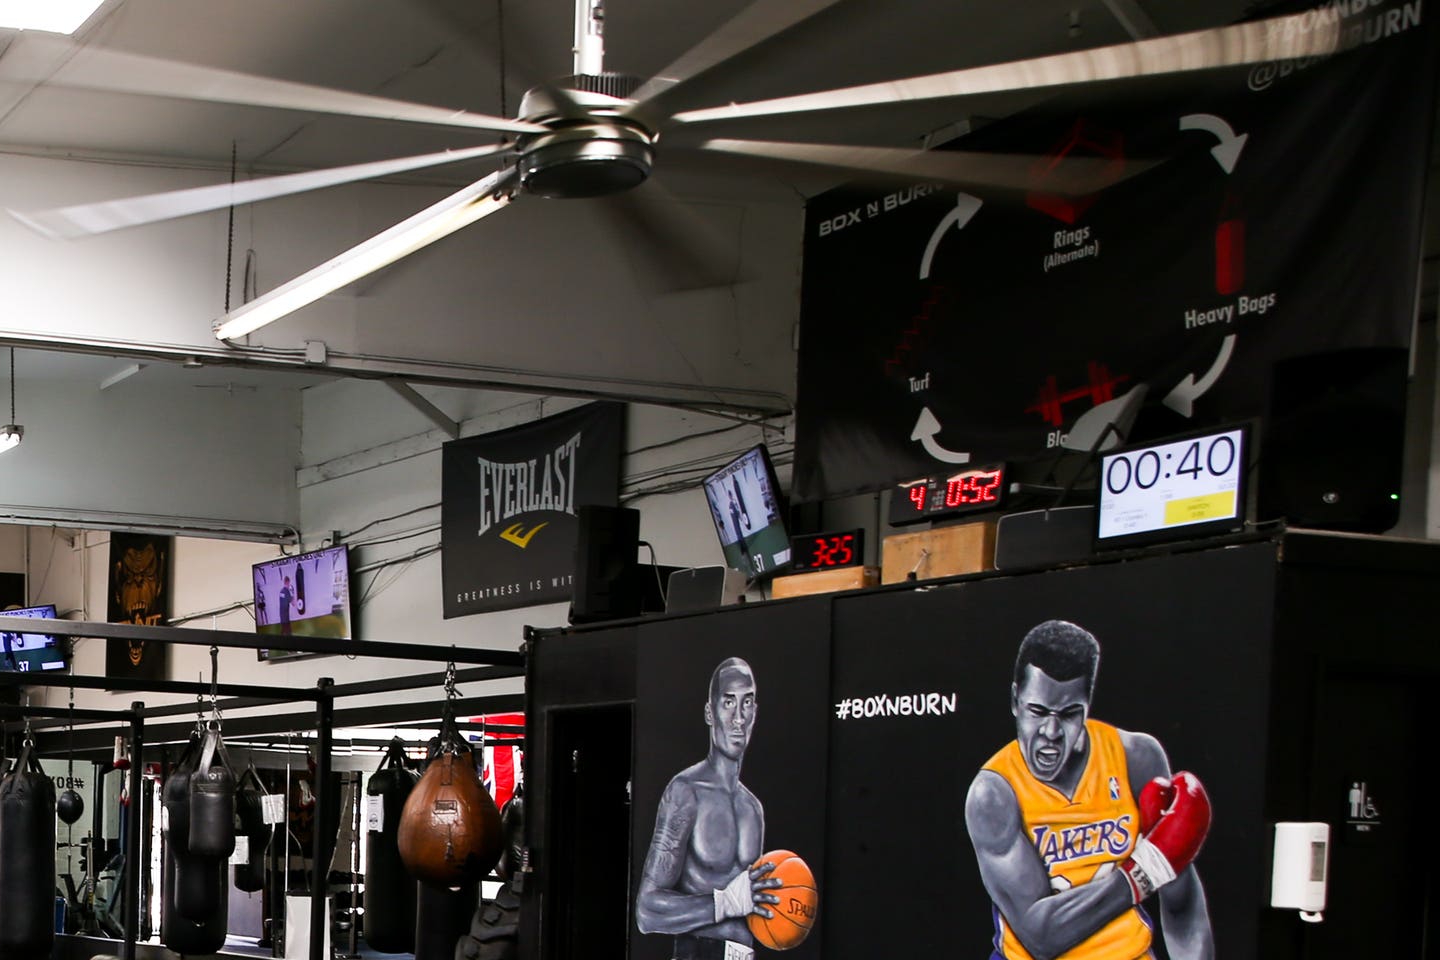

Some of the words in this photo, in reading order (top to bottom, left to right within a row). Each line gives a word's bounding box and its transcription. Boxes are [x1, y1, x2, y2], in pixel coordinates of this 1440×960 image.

[818, 208, 862, 237] BOX
[866, 200, 879, 218] N
[1053, 226, 1091, 249] Rings
[1043, 240, 1101, 272] (Alternate)
[1184, 304, 1234, 330] Heavy
[1238, 292, 1277, 315] Bags
[909, 372, 930, 393] Turf
[1106, 435, 1235, 494] 00:40
[477, 431, 581, 537] EVERLAST
[456, 583, 521, 603] GREATNESS
[529, 579, 542, 591] IS
[552, 575, 573, 588] WIT
[18, 660, 30, 672] 37
[835, 692, 957, 720] #BOXNBURN
[1032, 815, 1131, 868] LAKERS
